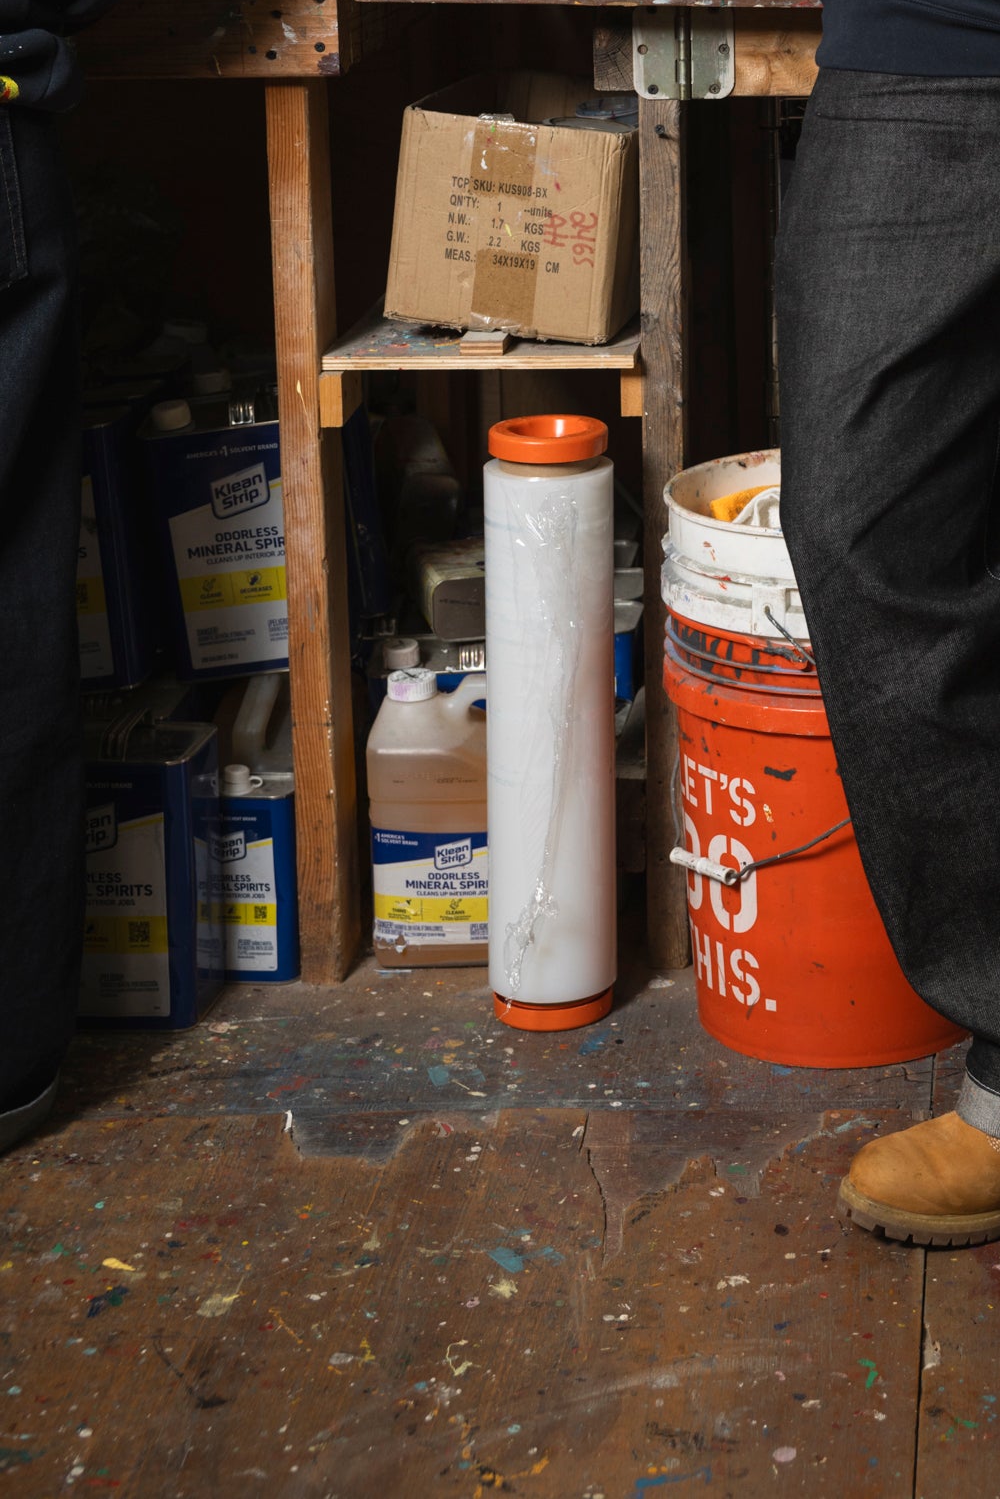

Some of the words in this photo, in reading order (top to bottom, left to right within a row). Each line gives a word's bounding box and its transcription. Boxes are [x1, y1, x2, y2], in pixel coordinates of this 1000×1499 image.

[452, 176, 470, 189] TCP
[473, 179, 496, 193] SKU:
[498, 182, 548, 198] KUS908-BX
[450, 194, 480, 209] QN'TY:
[497, 201, 502, 213] 1
[448, 212, 471, 226] N.W.:
[491, 218, 504, 230] 1.7
[524, 222, 544, 236] KGS
[446, 230, 470, 244] G.W.:
[520, 240, 541, 254] KGS
[445, 248, 476, 263] MEAS.:
[492, 254, 536, 270] 34X19X19
[545, 261, 560, 274] CM
[230, 445, 256, 454] SOLVENT
[257, 442, 279, 451] BRAND
[214, 474, 263, 498] Klean
[222, 487, 259, 510] Strip
[215, 526, 279, 543] ODORLESS
[187, 541, 248, 560] MINERAL
[256, 536, 285, 550] SPIR
[206, 556, 233, 565] CLEANS
[235, 555, 244, 563] UP
[245, 552, 275, 561] INTERIOR
[86, 813, 112, 829] ean
[86, 829, 110, 846] rip
[437, 844, 469, 858] Klean
[441, 853, 466, 865] Strip
[406, 880, 457, 890] MINERAL
[428, 872, 480, 881] ODORLESS
[96, 884, 153, 897] SPIRITS
[234, 883, 271, 893] SPIRITS
[690, 918, 777, 1012] HIS.
